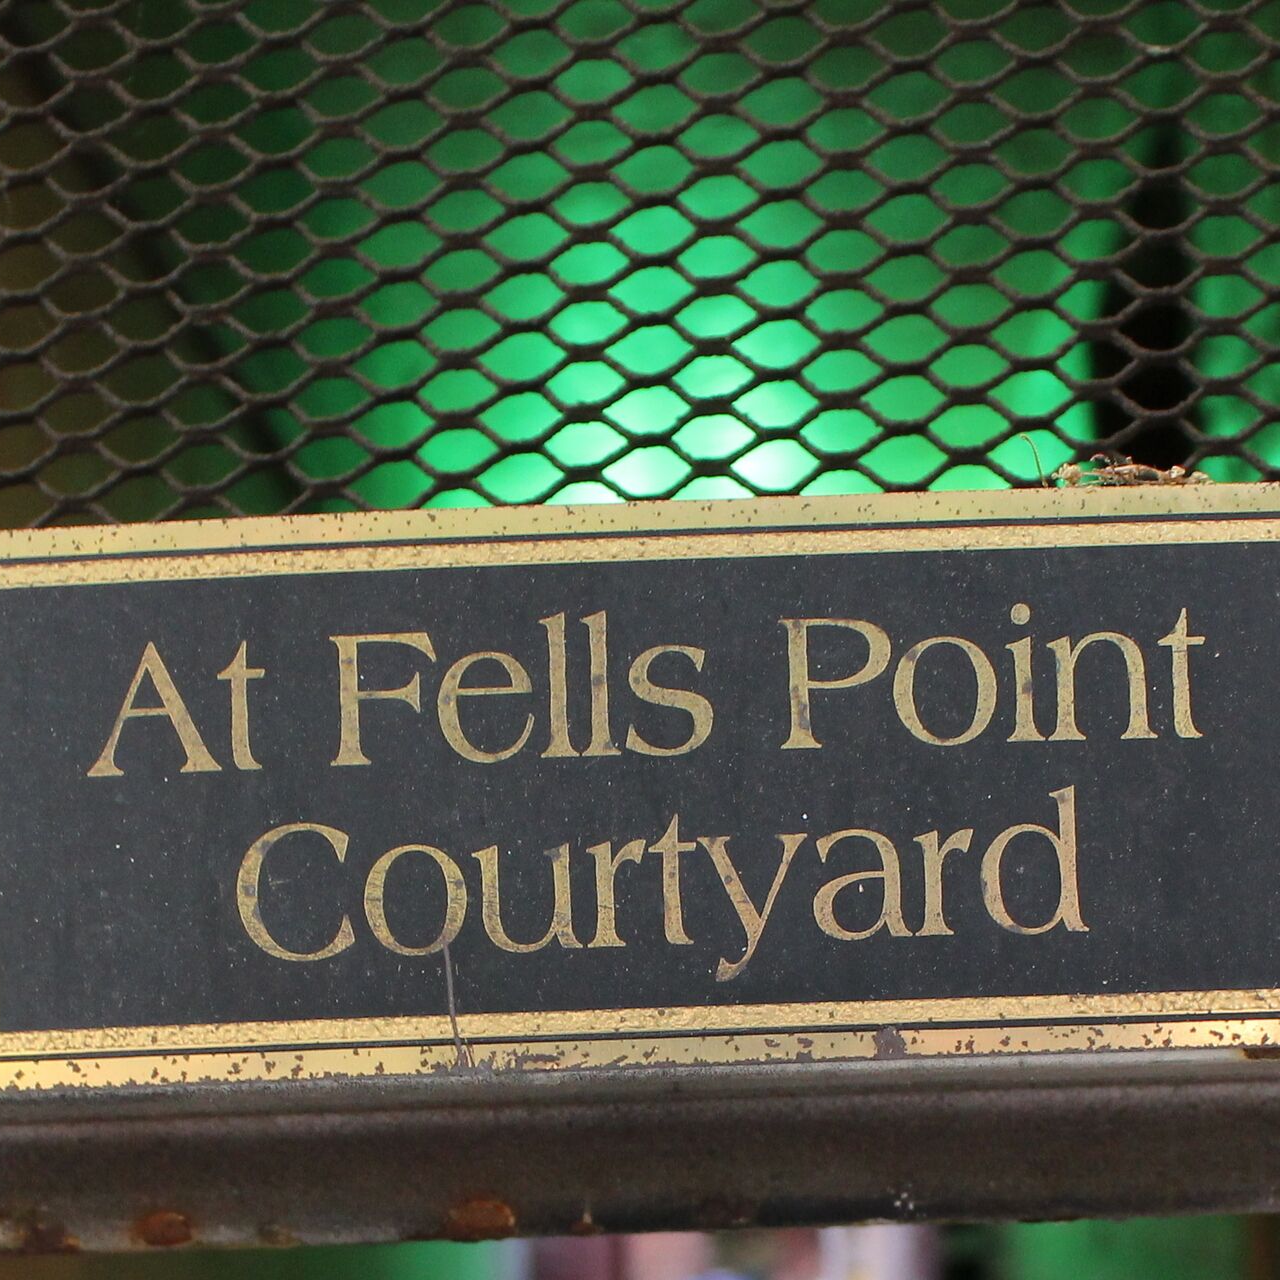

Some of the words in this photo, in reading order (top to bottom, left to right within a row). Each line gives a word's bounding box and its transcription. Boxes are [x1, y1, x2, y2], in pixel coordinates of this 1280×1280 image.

[86, 639, 266, 778] At
[328, 609, 715, 767] Fells
[777, 602, 1206, 750] Point
[236, 784, 1090, 982] Courtyard
